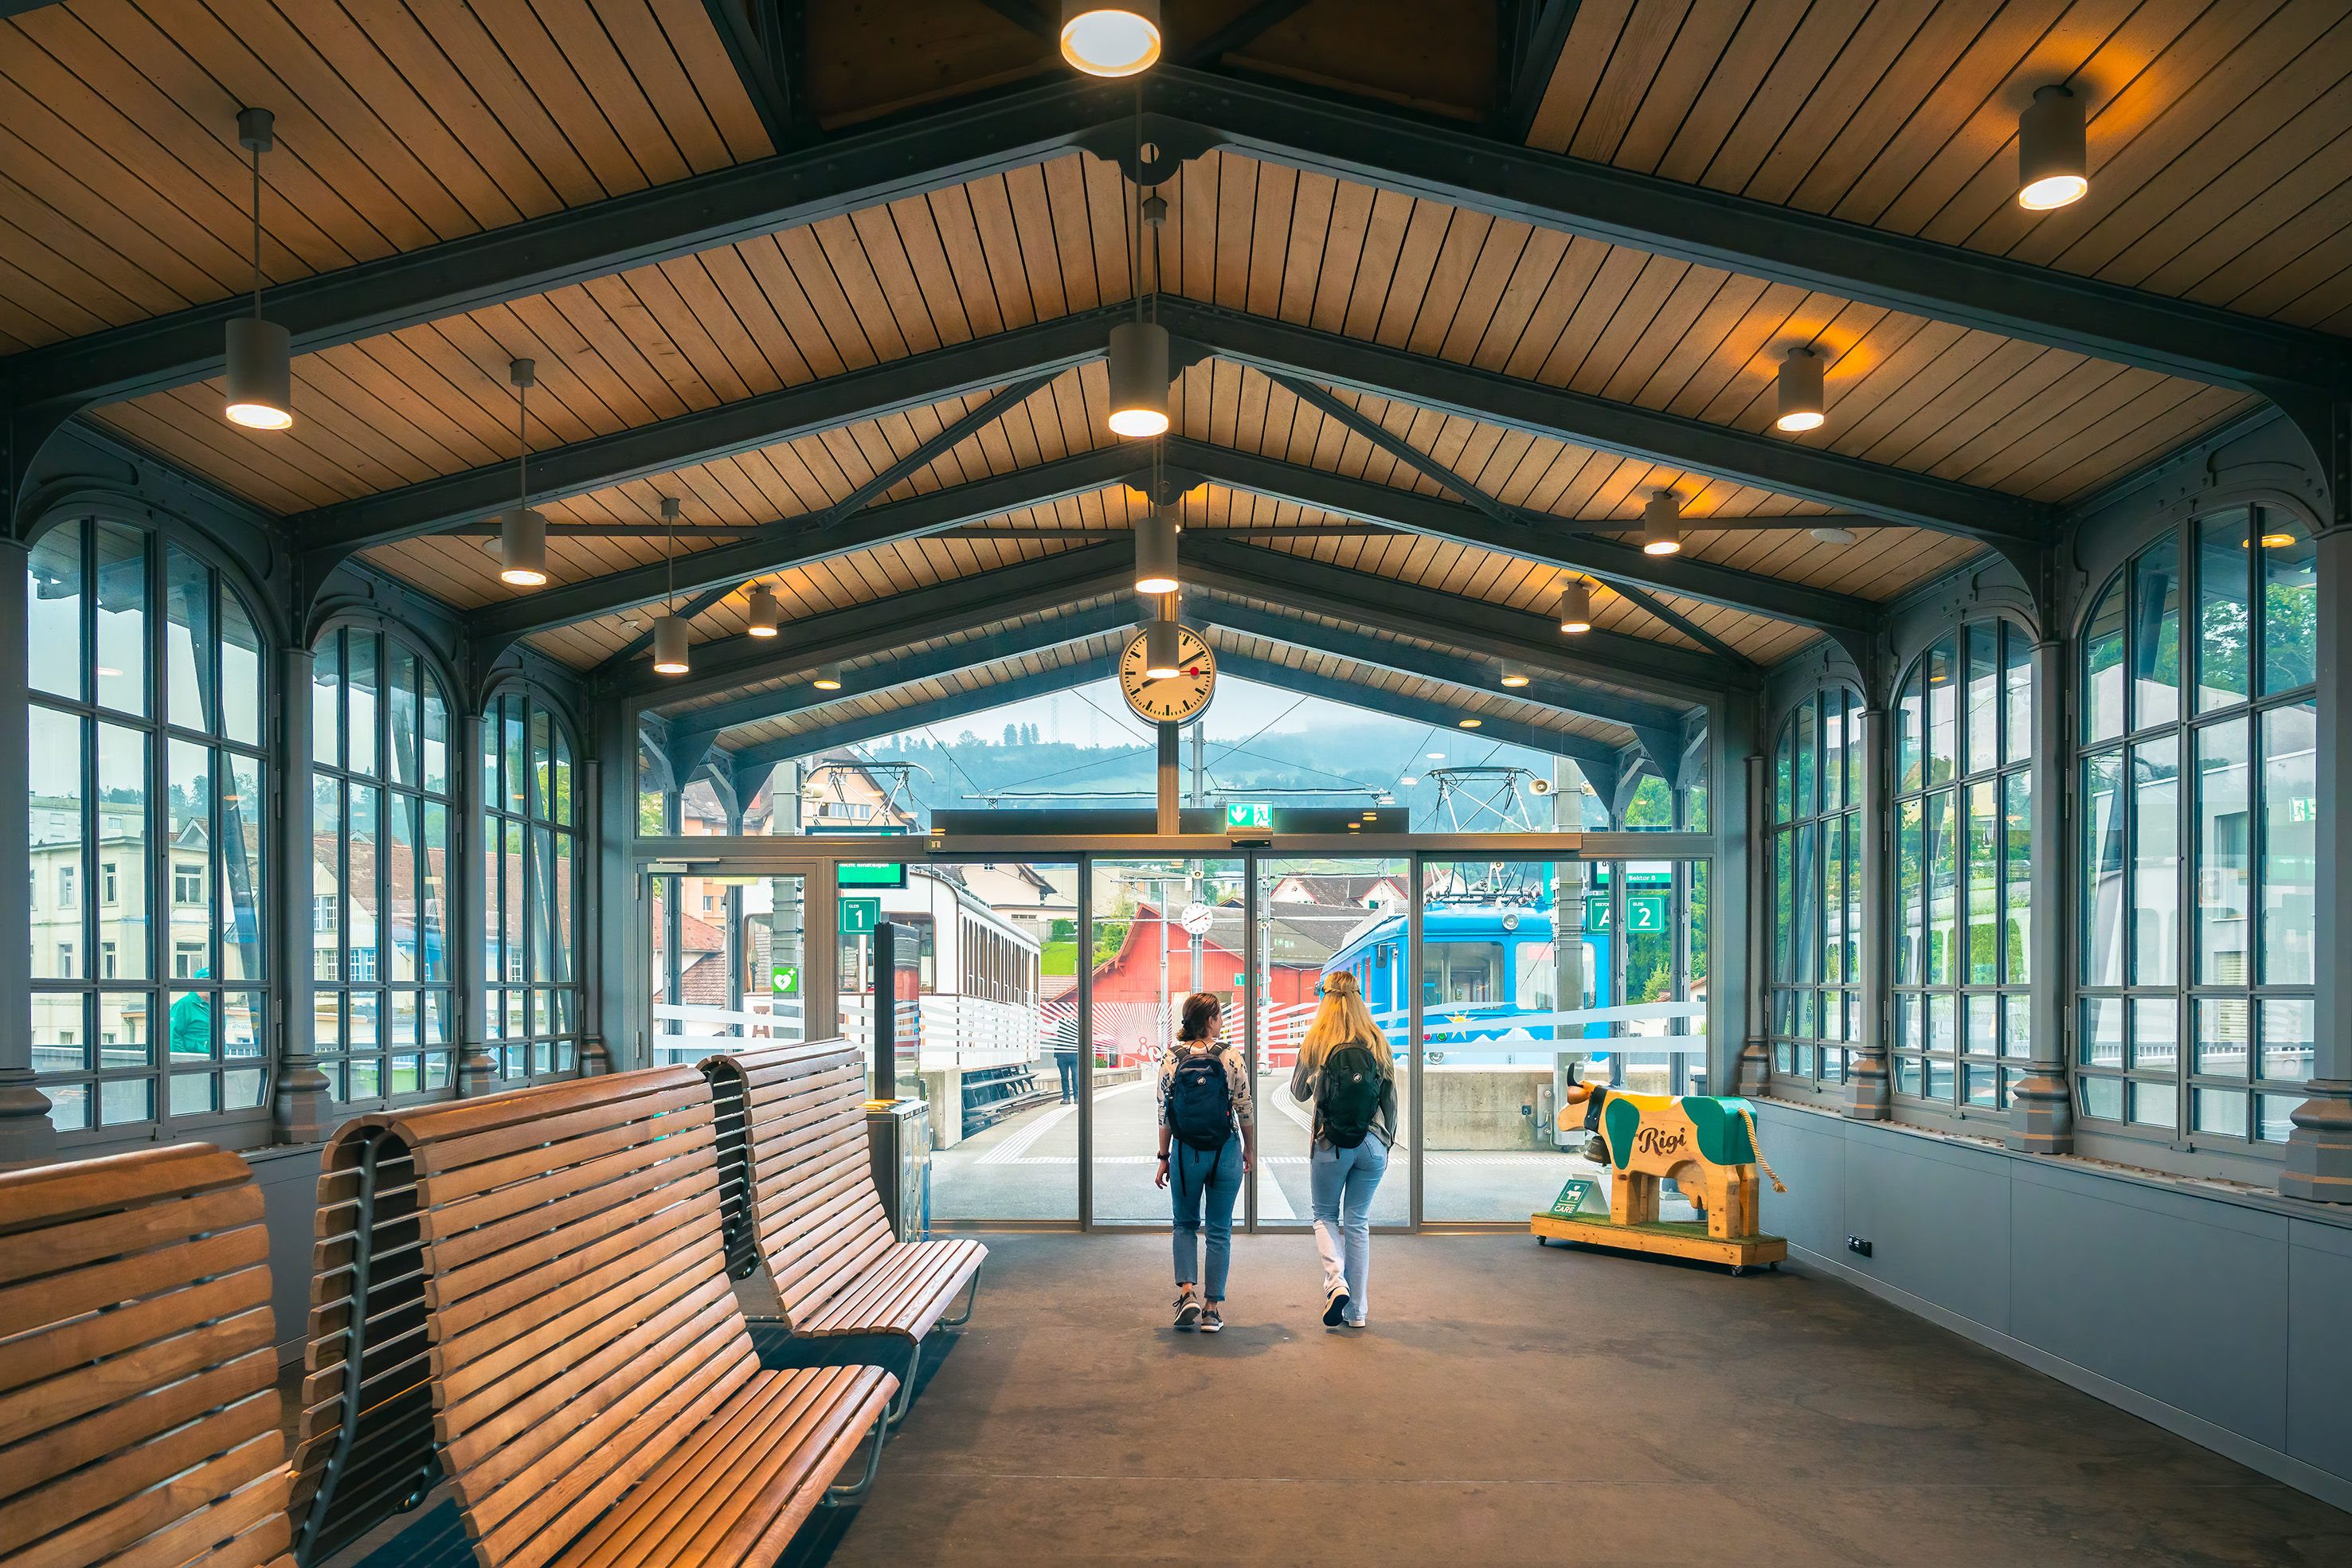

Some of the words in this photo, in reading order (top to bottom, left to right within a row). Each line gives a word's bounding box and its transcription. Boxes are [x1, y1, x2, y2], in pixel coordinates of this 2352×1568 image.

[855, 909, 862, 928] 1
[1599, 908, 1609, 926] A
[1638, 908, 1650, 926] 2
[1638, 1127, 1687, 1156] Rigi
[1554, 1205, 1575, 1214] CARE
